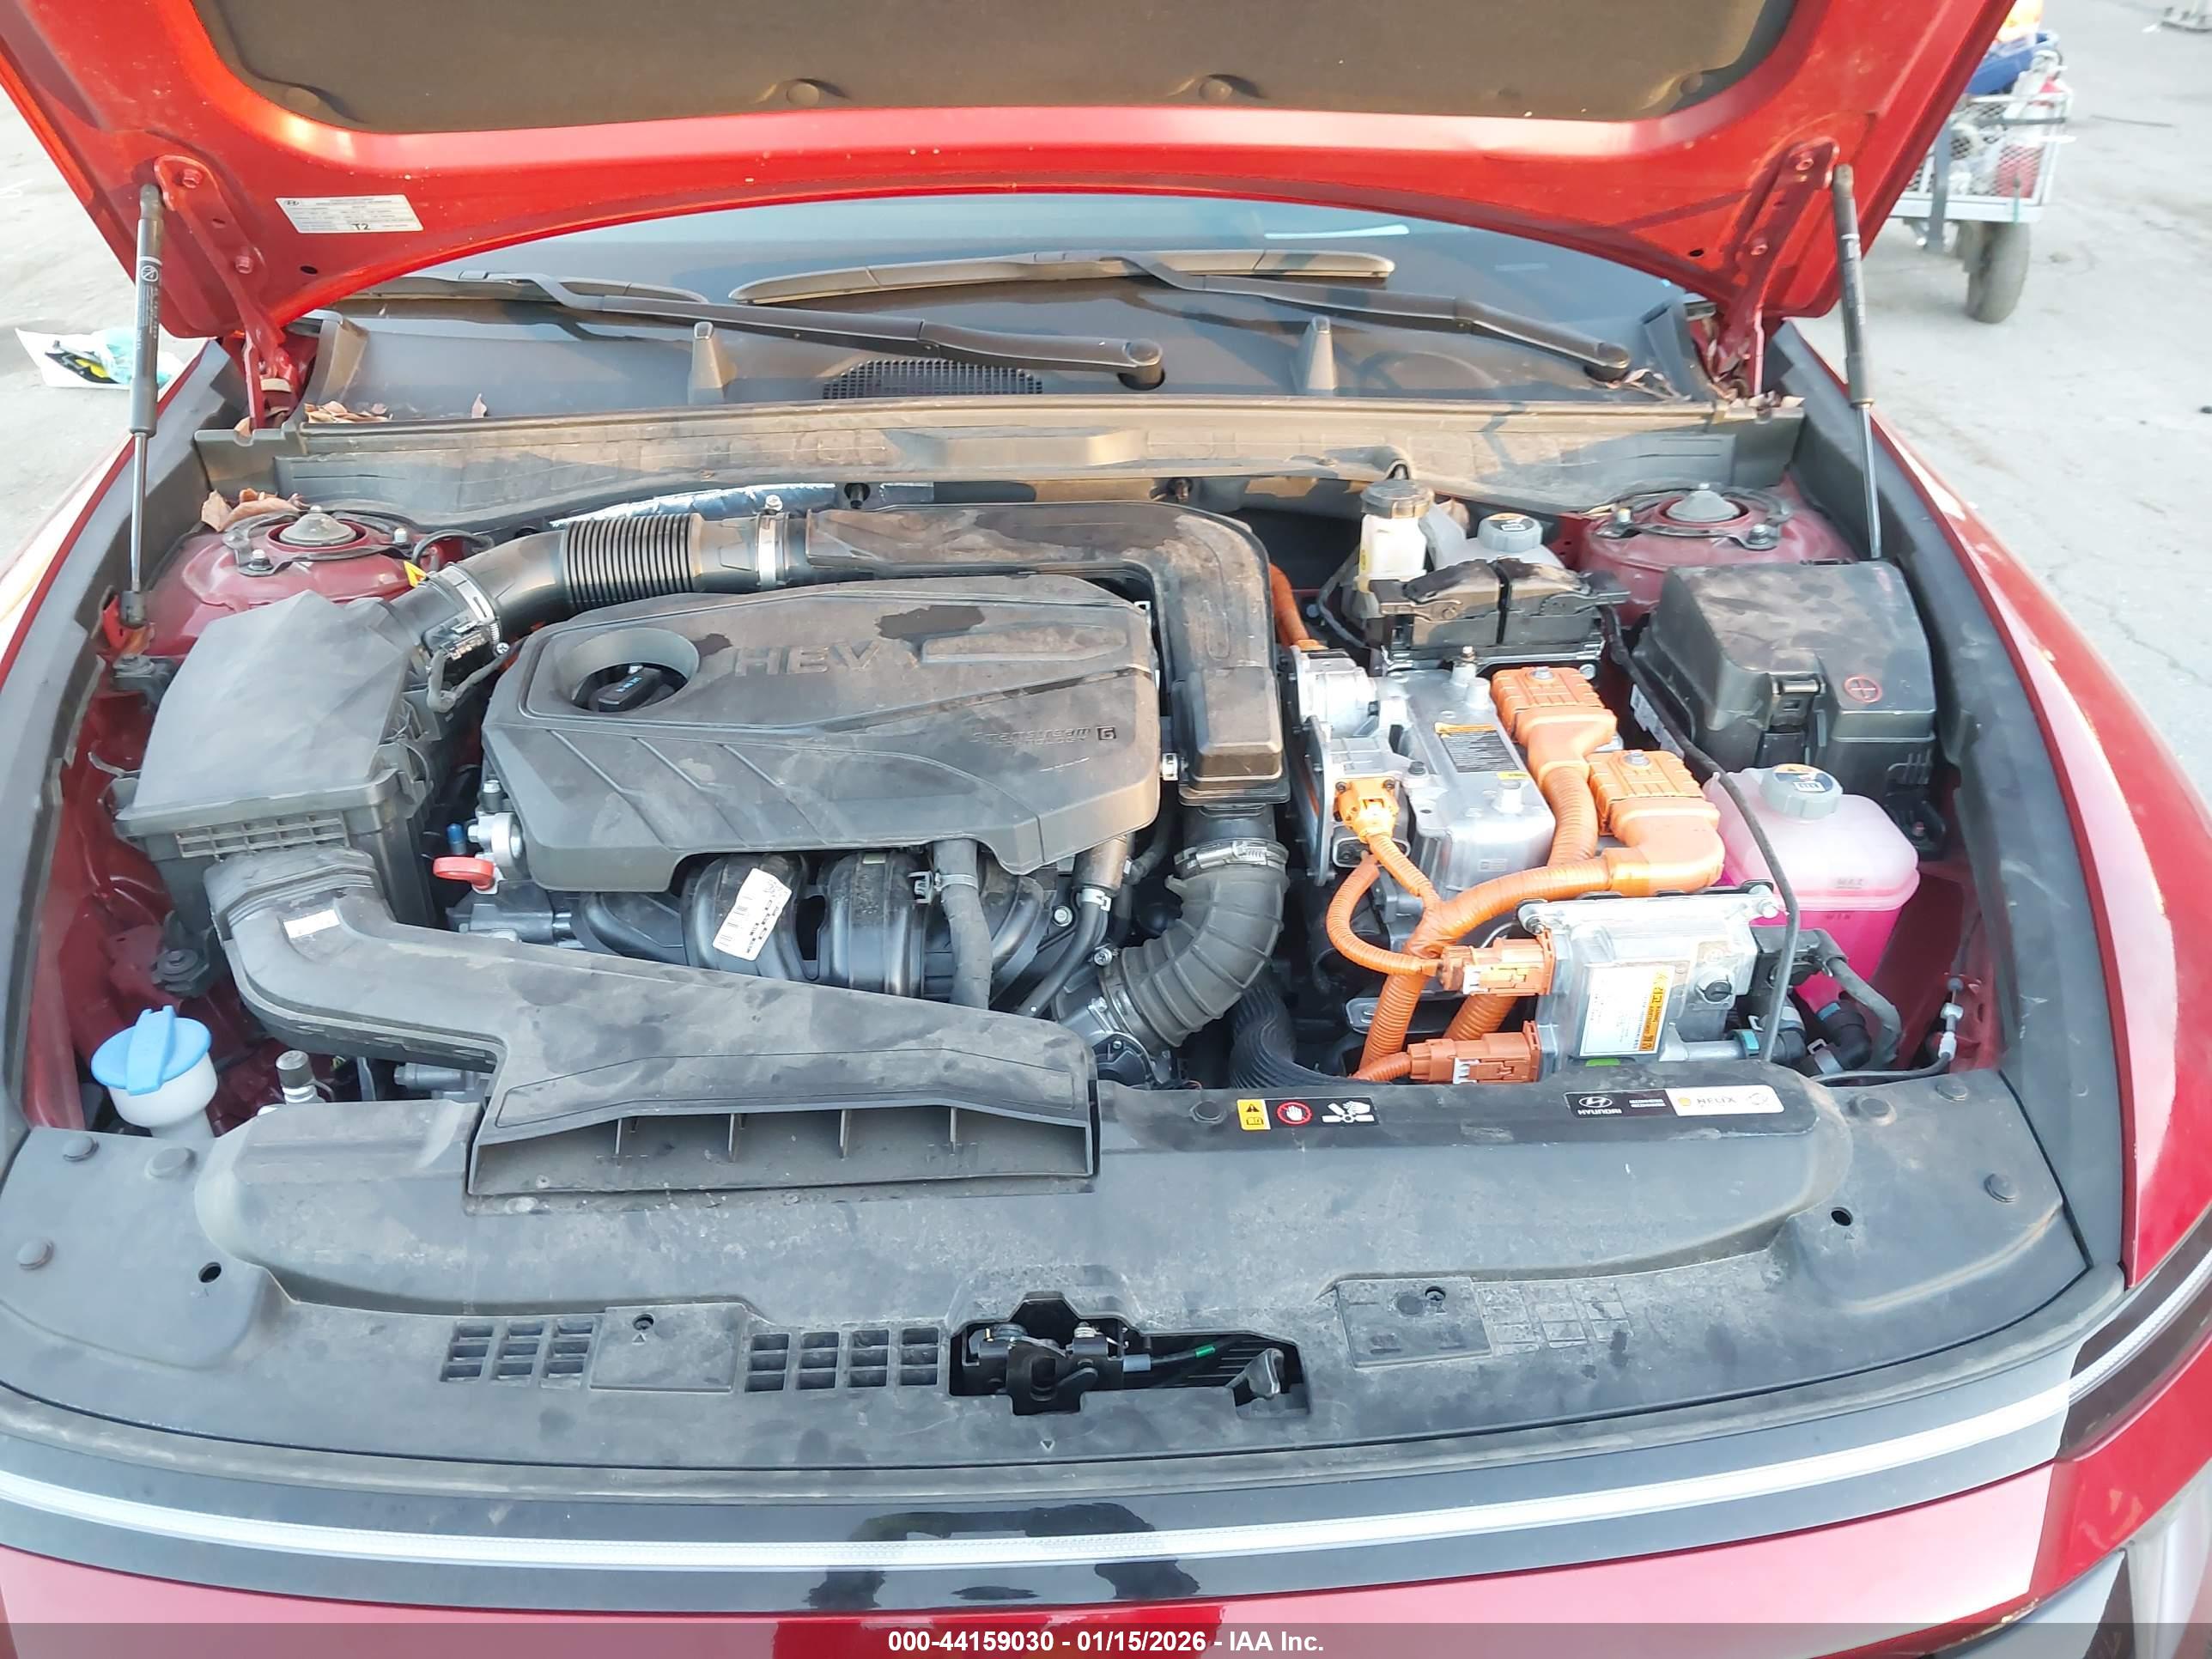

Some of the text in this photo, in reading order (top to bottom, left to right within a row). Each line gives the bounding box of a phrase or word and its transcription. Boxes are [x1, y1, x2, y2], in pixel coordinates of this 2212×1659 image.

[350, 222, 371, 231] T2
[734, 641, 881, 677] HEV
[1099, 726, 1115, 739] G
